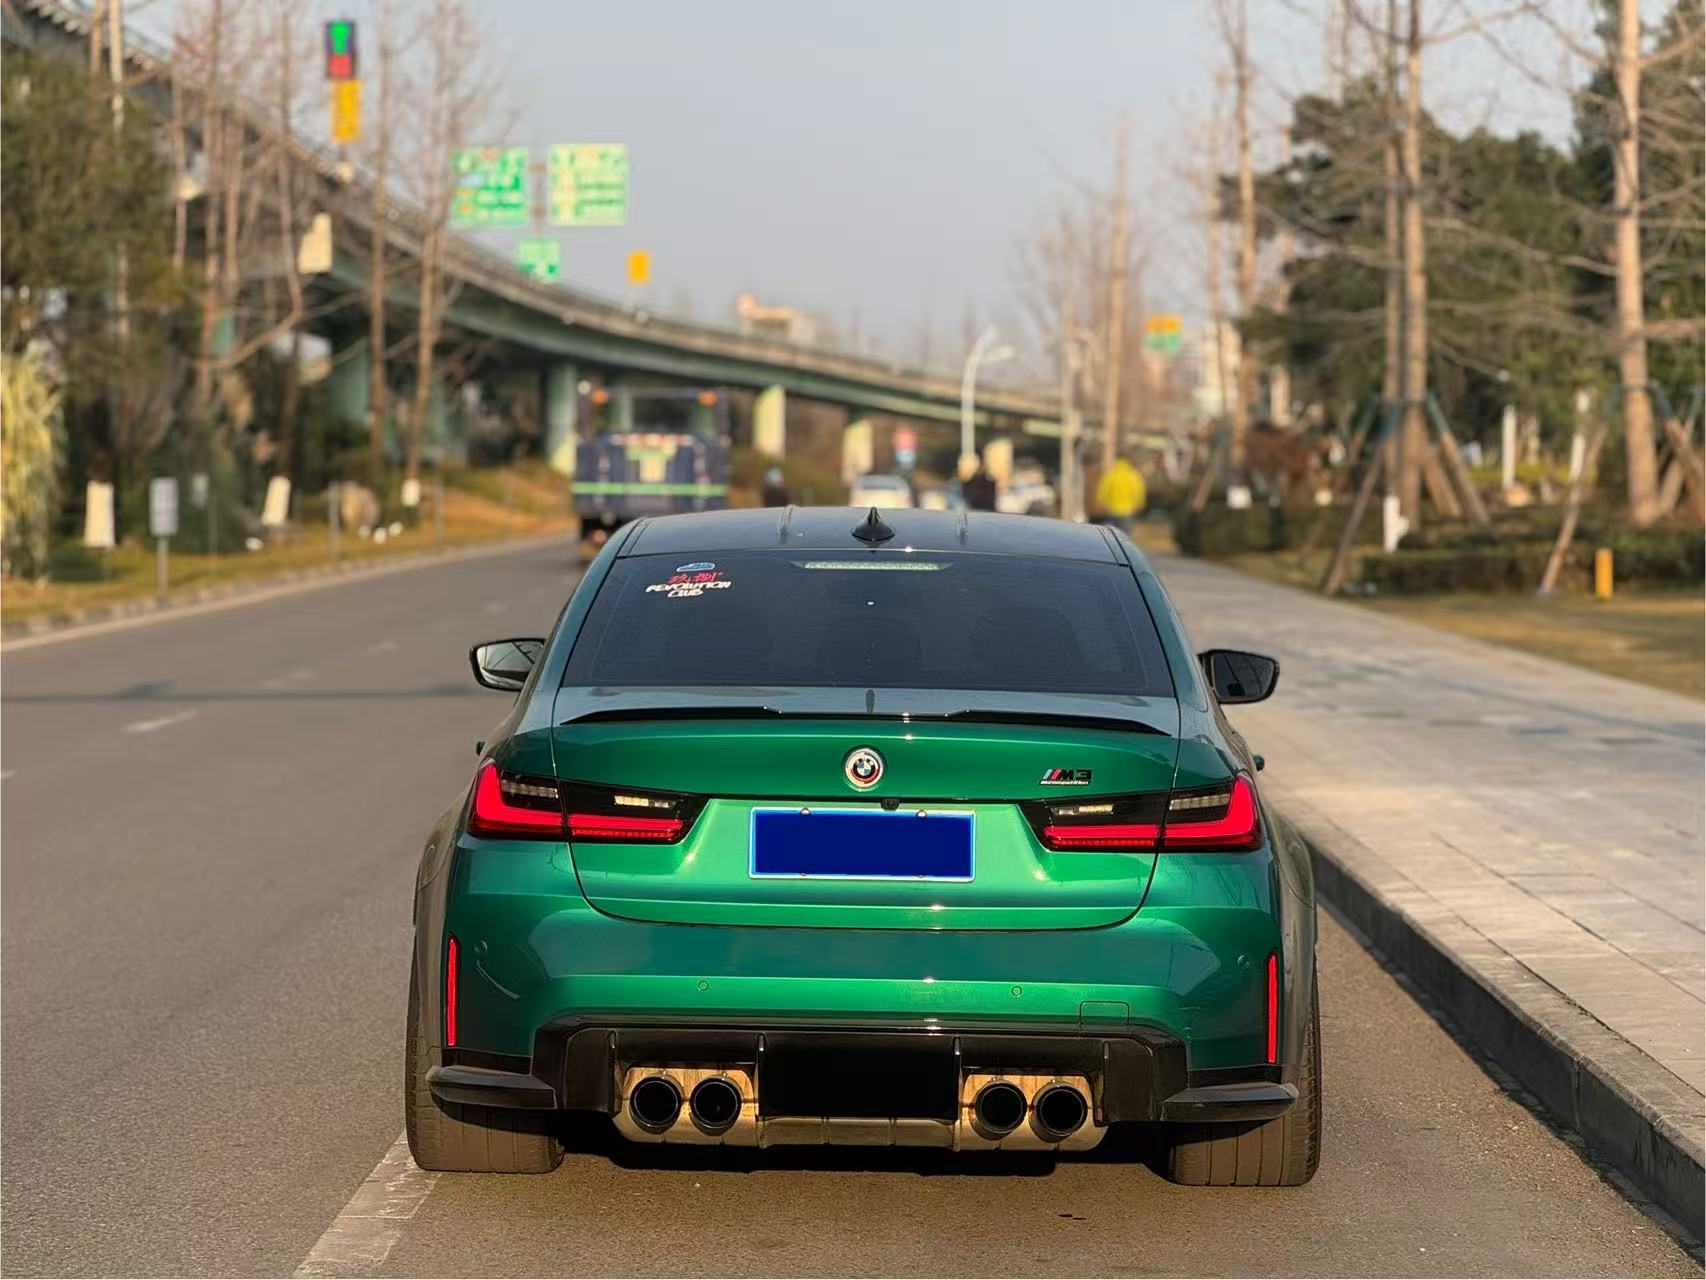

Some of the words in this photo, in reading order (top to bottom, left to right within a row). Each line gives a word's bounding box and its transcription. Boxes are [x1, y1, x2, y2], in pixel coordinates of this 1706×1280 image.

[645, 581, 732, 593] REVOLUTION
[667, 589, 704, 598] CLUB
[1057, 768, 1092, 781] M3
